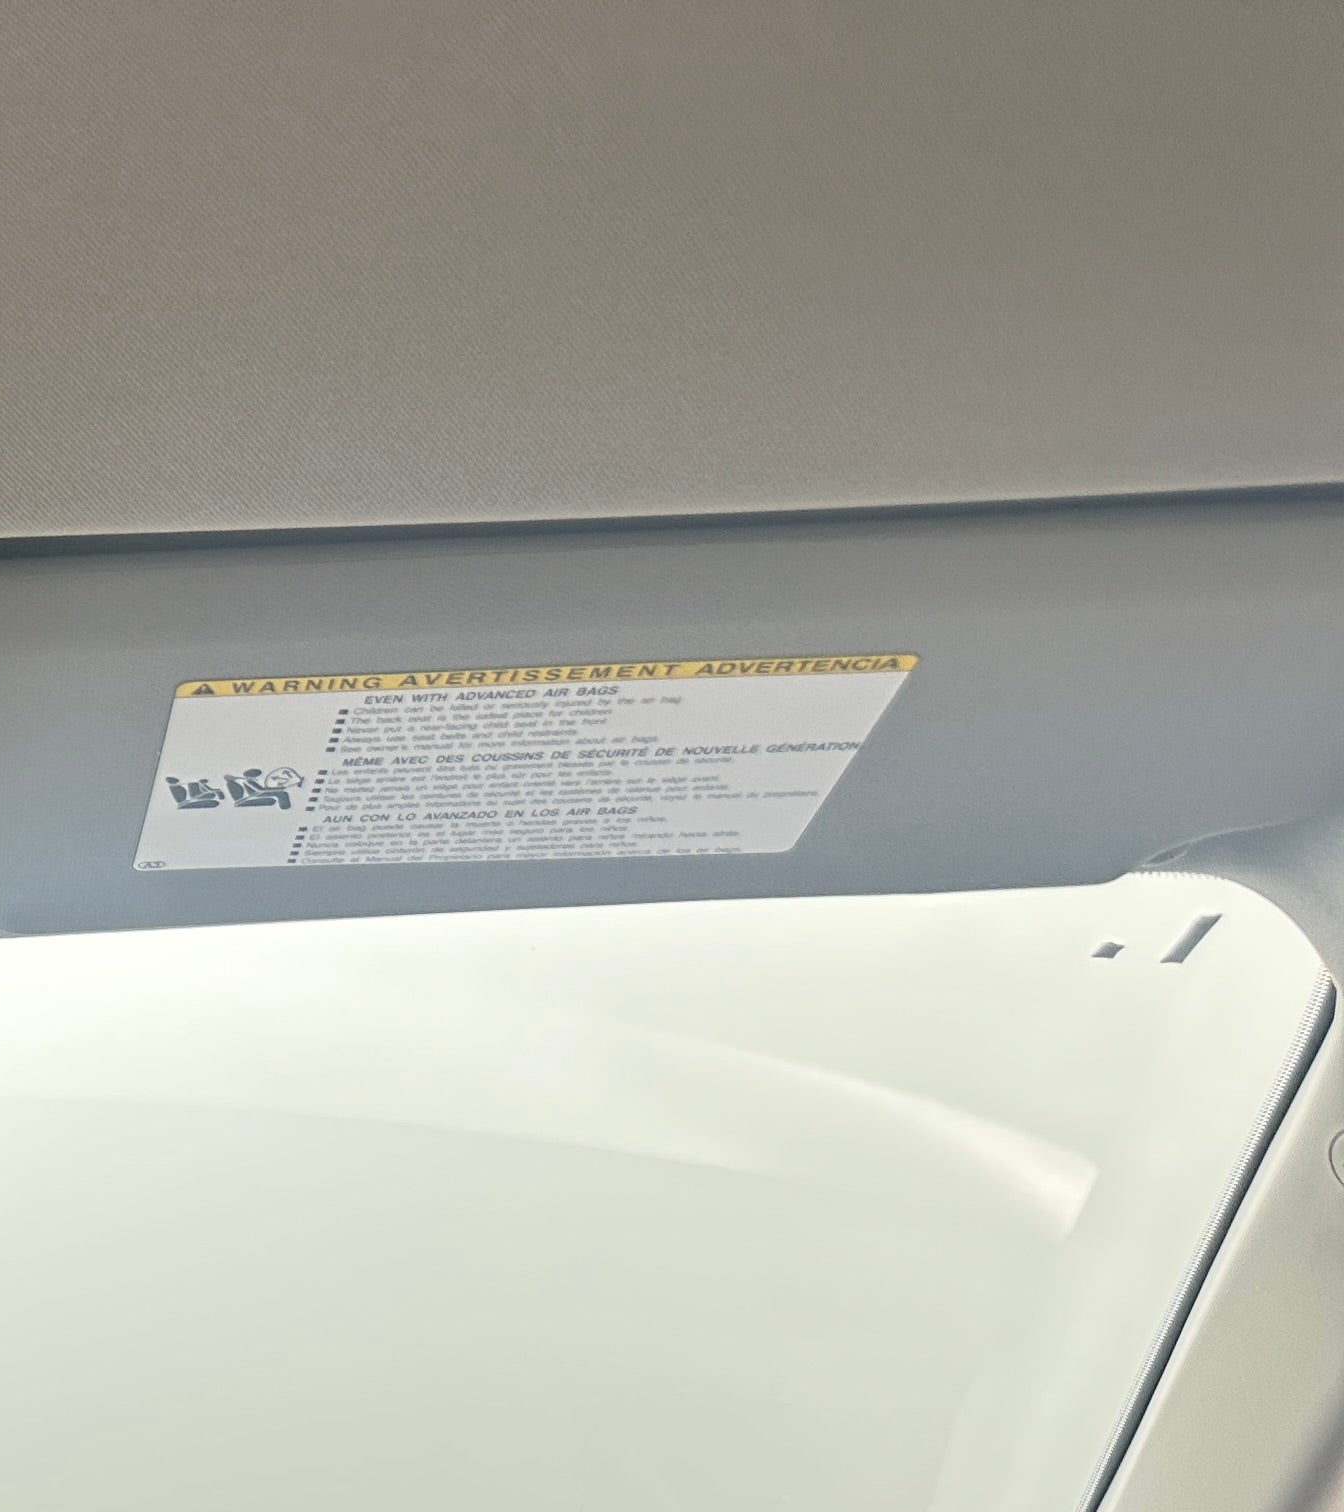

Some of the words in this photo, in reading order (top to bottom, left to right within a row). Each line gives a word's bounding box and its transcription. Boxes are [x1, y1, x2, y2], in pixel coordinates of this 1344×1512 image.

[231, 675, 383, 695] WARNING
[399, 665, 678, 687] AVERTISSEMENT
[695, 657, 900, 676] ADVERTENCIA
[364, 694, 403, 704] EVEN
[411, 693, 448, 702] WITH
[456, 689, 536, 700] ADVANCED
[545, 688, 568, 697] AIR
[576, 685, 619, 696] BAGS
[391, 755, 428, 764] AVEC
[435, 754, 465, 763] DES
[471, 751, 544, 762] COUSSINS
[550, 750, 571, 759] DE
[577, 747, 650, 758] SÉCURITÉ
[654, 747, 676, 756] DE
[681, 744, 761, 755] NOUVELLE
[765, 742, 859, 754] GÉNÉRATION
[323, 815, 353, 823] AUN
[359, 813, 390, 822] CON
[396, 813, 417, 821] LO
[423, 810, 498, 820] AVANZADO
[504, 809, 525, 817] EN
[530, 808, 561, 817] LOS
[566, 807, 591, 815] AIR
[596, 806, 638, 814] BAGS
